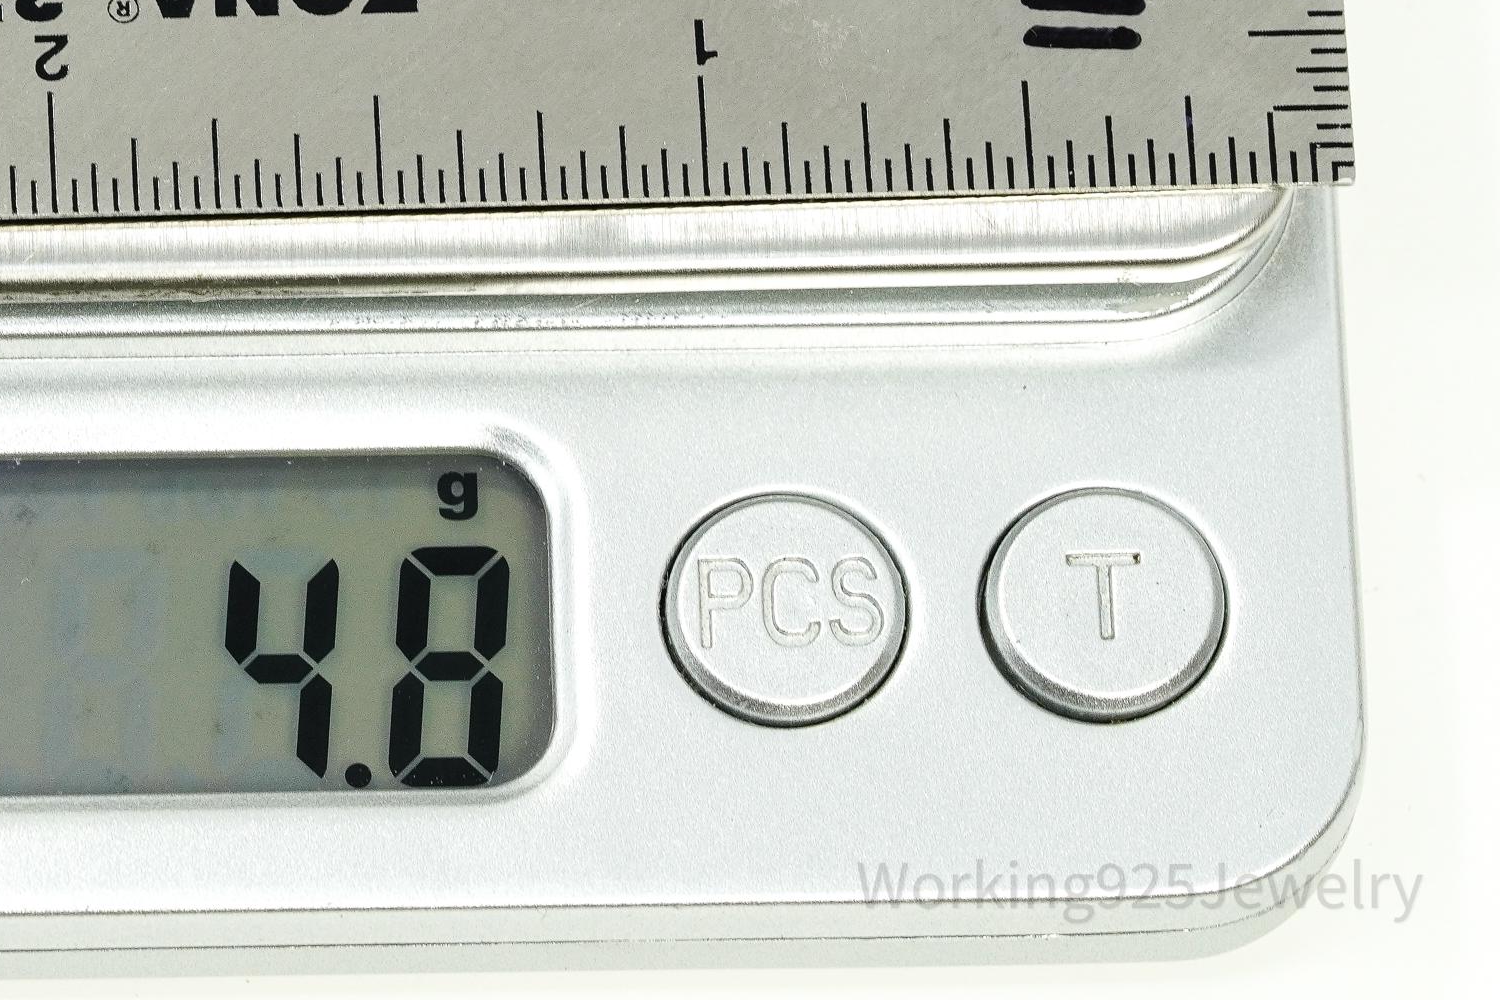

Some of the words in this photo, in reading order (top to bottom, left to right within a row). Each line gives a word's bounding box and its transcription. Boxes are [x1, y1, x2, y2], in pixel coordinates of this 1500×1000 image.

[34, 33, 70, 82] 2
[693, 18, 719, 66] 1
[437, 470, 480, 521] g
[695, 555, 886, 650] PCS
[1065, 551, 1142, 641] T
[223, 544, 512, 790] 4.8
